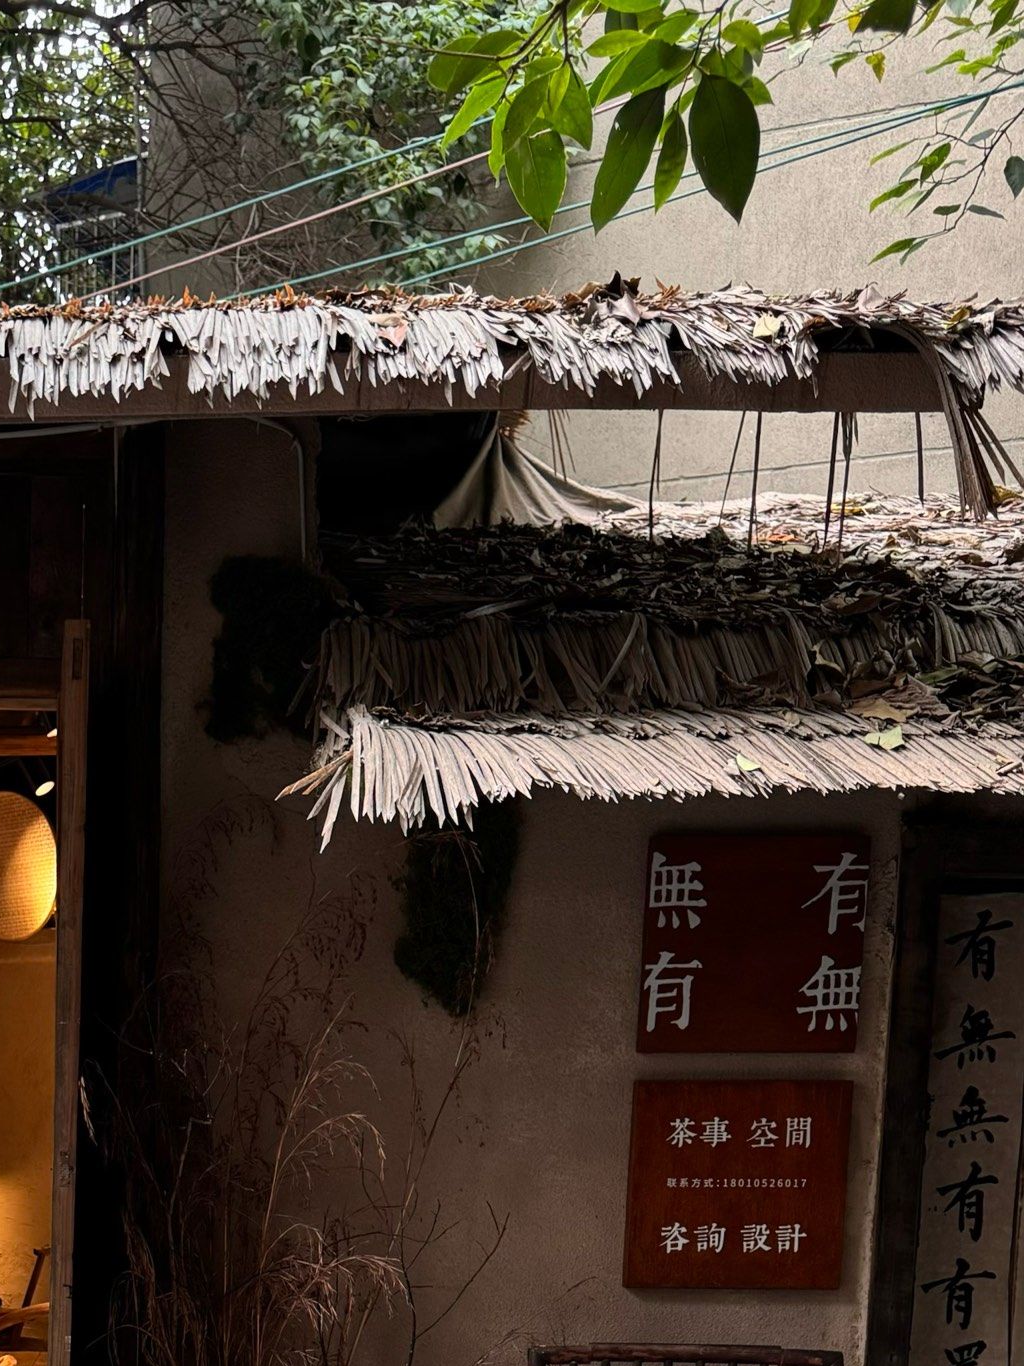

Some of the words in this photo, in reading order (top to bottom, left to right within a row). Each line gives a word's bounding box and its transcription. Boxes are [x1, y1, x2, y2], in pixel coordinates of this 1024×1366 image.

[666, 1117, 732, 1148] 茶事
[746, 1117, 812, 1148] 空間
[659, 1221, 726, 1254] 咨詢
[740, 1223, 807, 1254] 設計
